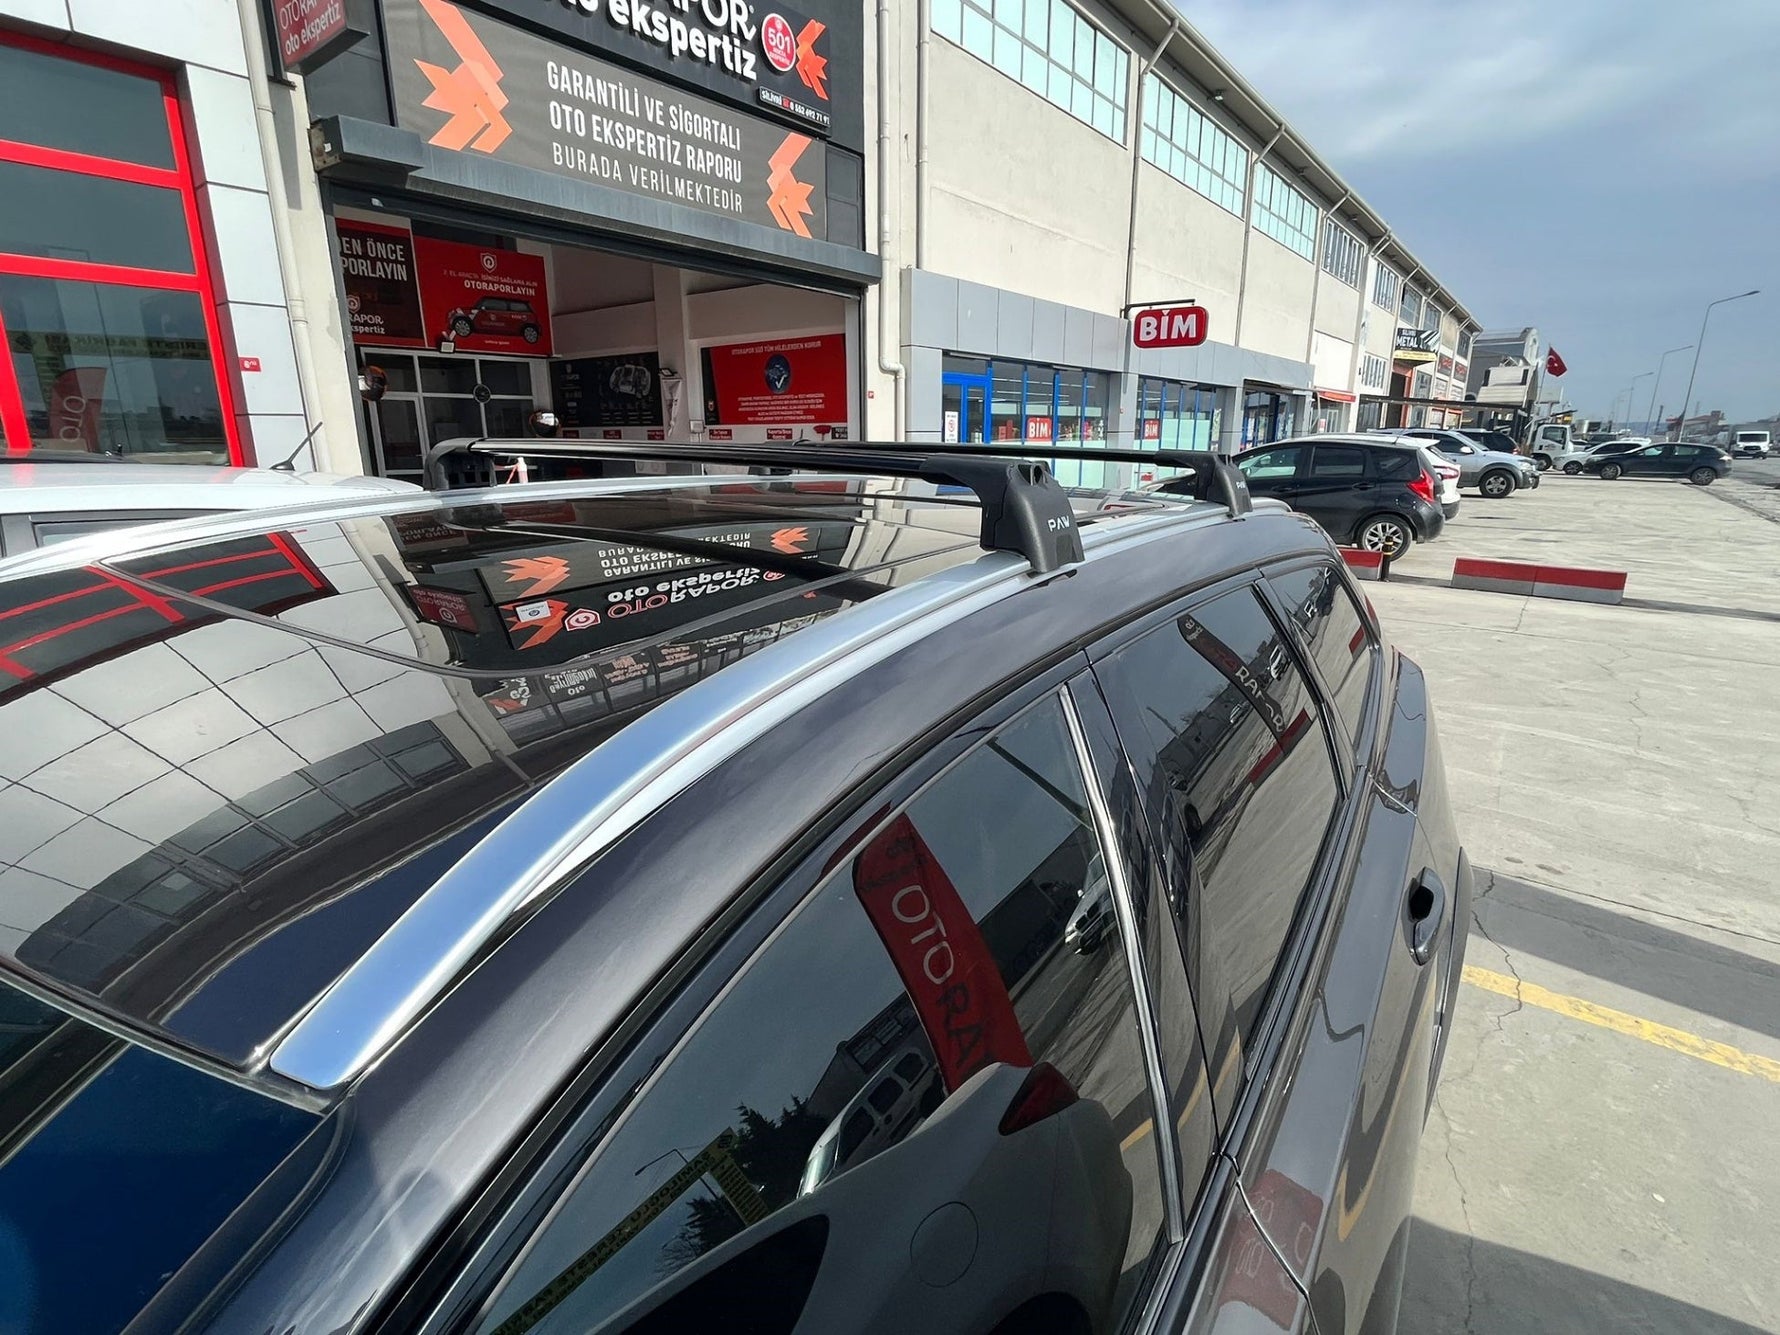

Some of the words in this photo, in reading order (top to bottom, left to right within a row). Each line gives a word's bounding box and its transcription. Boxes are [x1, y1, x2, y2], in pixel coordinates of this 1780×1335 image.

[285, 33, 300, 55] oto
[301, 0, 341, 44] ekspertiz
[609, 0, 757, 80] ekspertiz
[768, 27, 791, 54] 501
[547, 61, 640, 118] GARANTİLİ
[644, 95, 665, 126] VE
[669, 104, 741, 151] SİGORTALI
[550, 101, 586, 137] OTO
[591, 114, 682, 166] EKSPERTİZ
[686, 144, 742, 184] RAPORU
[553, 142, 623, 183] BURADA
[629, 163, 743, 213] VERİLMEKTEDİR
[366, 237, 405, 261] ÖNCE
[464, 279, 536, 296] OTORAPORLAYIN
[1140, 310, 1197, 342] BİM
[1396, 336, 1418, 348] METAL
[1029, 418, 1049, 438] BİM
[1048, 515, 1070, 532] PAW
[892, 884, 988, 1071] OTORA
